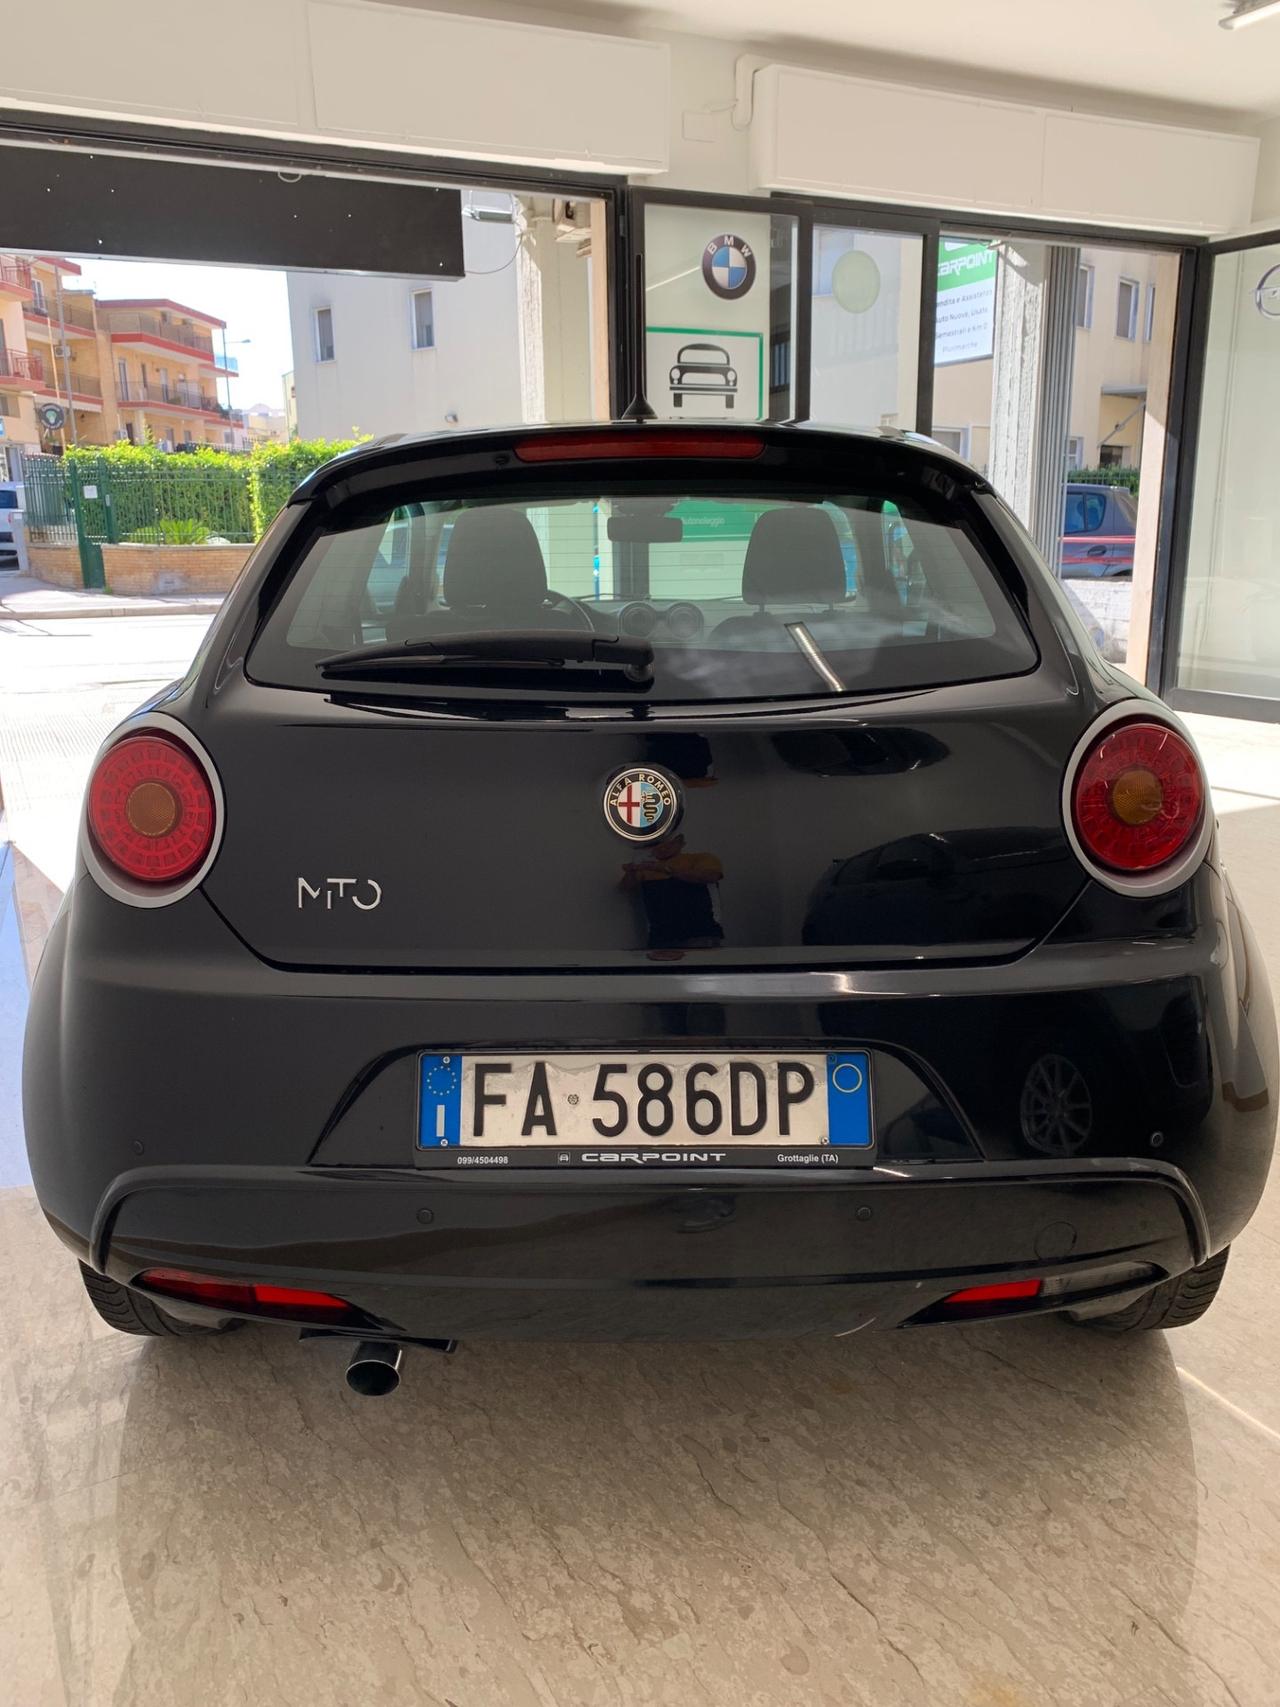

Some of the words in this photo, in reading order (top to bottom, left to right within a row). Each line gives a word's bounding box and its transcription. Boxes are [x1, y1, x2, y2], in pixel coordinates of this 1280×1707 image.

[706, 235, 752, 257] BMW
[938, 251, 993, 276] ARPOINT
[609, 777, 632, 807] ALFA
[638, 773, 671, 806] ROMEO
[473, 1062, 557, 1136] FA
[592, 1061, 815, 1137] 586DP
[457, 1155, 509, 1165] 099/4504498
[777, 1153, 819, 1164] Grottaglie
[821, 1153, 839, 1164] (TA)
